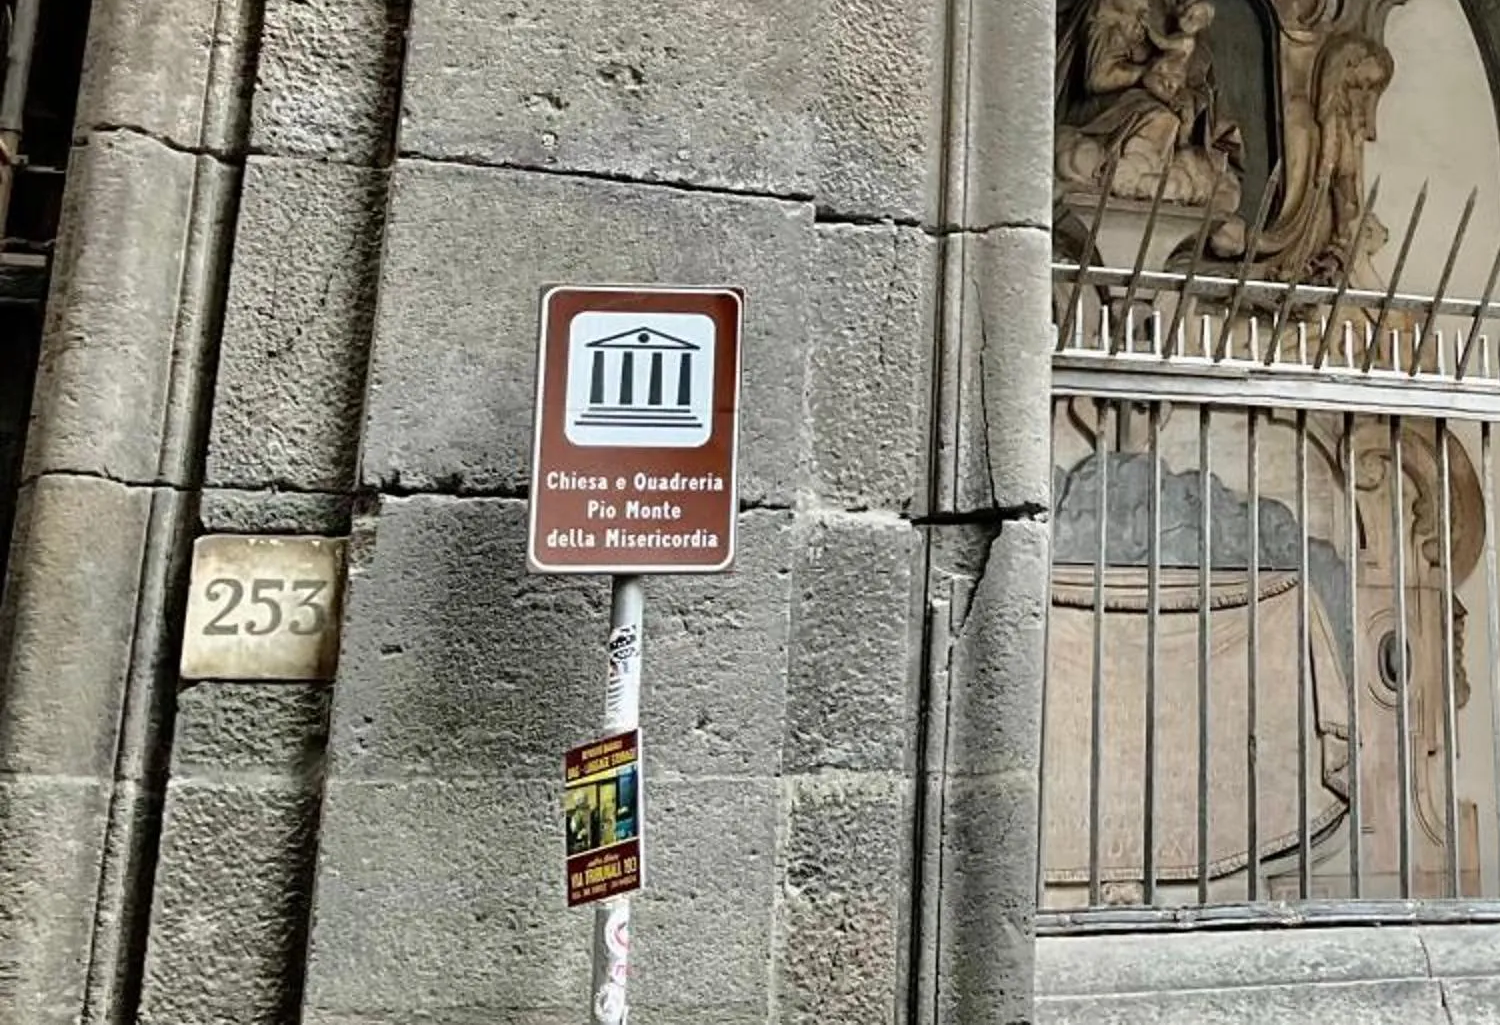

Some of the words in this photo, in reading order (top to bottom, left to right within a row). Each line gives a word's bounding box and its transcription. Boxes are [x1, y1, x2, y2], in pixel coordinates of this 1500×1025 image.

[546, 471, 608, 491] Chiesa
[615, 477, 626, 491] e
[633, 472, 723, 492] Quadreria
[587, 500, 617, 520] Pio
[625, 501, 682, 520] Monte
[547, 529, 595, 549] della
[605, 529, 719, 549] Misericordia
[202, 578, 328, 636] 253
